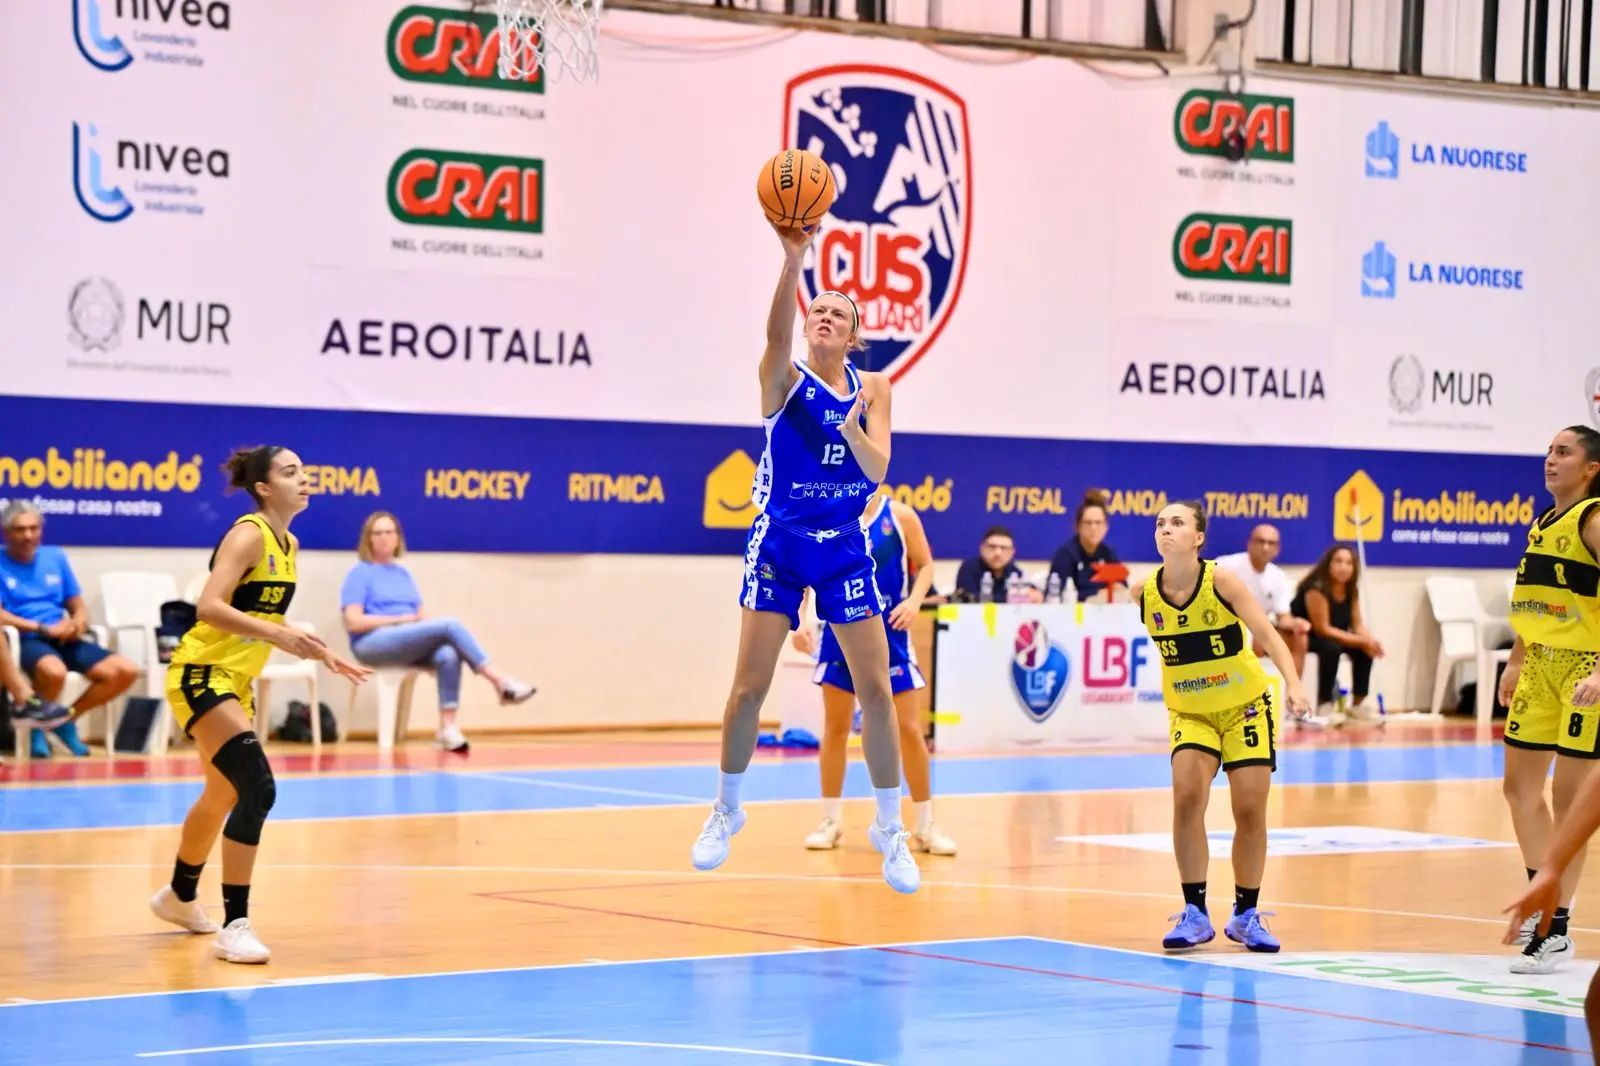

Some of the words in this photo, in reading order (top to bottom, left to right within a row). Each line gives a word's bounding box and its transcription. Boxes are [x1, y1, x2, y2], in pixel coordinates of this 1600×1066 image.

[115, 0, 230, 30] nivea
[395, 15, 538, 82] CRAI
[392, 96, 417, 109] NEL
[422, 98, 467, 113] CUORE
[1180, 97, 1290, 152] CRAI
[117, 140, 229, 178] nivea
[1411, 144, 1435, 164] LA
[1441, 146, 1527, 173] NUORESE
[396, 158, 538, 222] CRAI
[391, 239, 417, 252] NEL
[422, 240, 467, 255] CUORE
[1179, 220, 1288, 274] CRAI
[821, 227, 924, 302] CUS
[1408, 262, 1432, 284] LA
[1438, 265, 1523, 290] NUORESE
[137, 298, 231, 345] MUR
[321, 318, 592, 366] AEROITALIA
[1120, 362, 1325, 399] AEROITALIA
[1432, 370, 1493, 406] MUR
[821, 443, 846, 465] 12
[304, 465, 380, 496] ERMA
[425, 468, 530, 500] HOCKEY
[568, 472, 665, 503] RITMICA
[804, 482, 868, 490] SARDEGNA
[986, 485, 1066, 515] FUTSAL
[1205, 491, 1308, 518] TRIATHLON
[1393, 488, 1533, 525] imobiliando
[843, 578, 865, 602] 12
[1209, 634, 1226, 656] 5
[1083, 636, 1148, 687] LBF
[1026, 671, 1057, 694] LBF
[1173, 671, 1228, 689] ardiniarent
[1243, 725, 1259, 748] 5
[1568, 712, 1583, 738] 8
